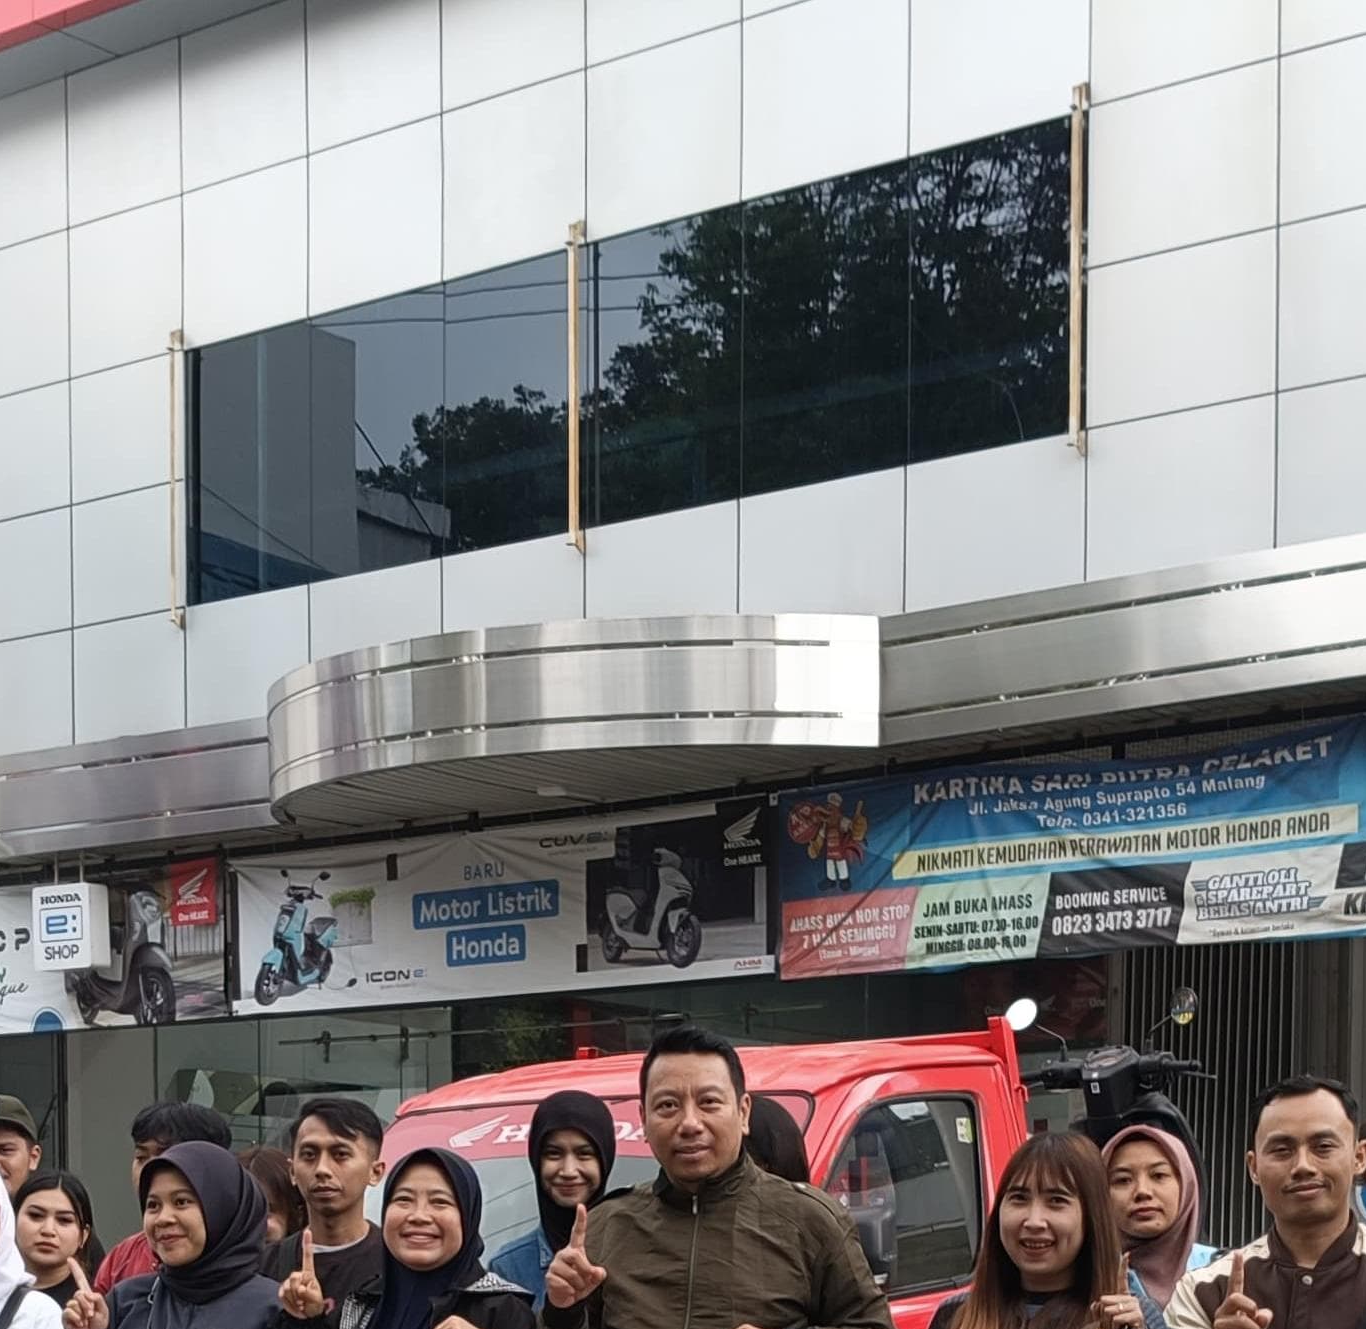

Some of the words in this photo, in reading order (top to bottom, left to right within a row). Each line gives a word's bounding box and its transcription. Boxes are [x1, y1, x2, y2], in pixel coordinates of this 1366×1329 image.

[914, 775, 1024, 804] KARTIKA
[969, 801, 988, 816] Jl.
[1044, 795, 1090, 814] Agung
[1096, 785, 1170, 809] Suprapto
[1176, 782, 1196, 796] 54
[1202, 774, 1265, 793] Malang
[1037, 813, 1077, 829] Telp.
[1082, 802, 1187, 827] 0341-321356
[723, 838, 762, 851] HONDA
[917, 850, 974, 873] NIKMATI
[978, 838, 1067, 867] KEMUDAHAN
[1071, 832, 1162, 858] PERAWATAN
[1167, 826, 1221, 851] MOTOR
[1226, 818, 1281, 843] HONDA
[1286, 812, 1330, 834] ANDA
[463, 860, 504, 881] BARU
[1208, 871, 1264, 890] GANTI
[1266, 867, 1299, 886] OLI
[40, 892, 81, 905] HONDA
[1055, 890, 1110, 910] BOOKING
[1113, 886, 1167, 906] SERVICE
[1207, 881, 1311, 903] SPAREPART
[420, 894, 482, 924] Motor
[487, 885, 553, 918] Listrik
[923, 900, 951, 917] JAM
[954, 897, 987, 915] BUKA
[991, 893, 1032, 911] AHASS
[1197, 900, 1250, 921] BEBAS
[1253, 895, 1309, 915] ANTRI
[45, 914, 77, 935] e:
[790, 916, 823, 933] AHASS
[856, 907, 881, 924] NON
[882, 904, 910, 922] STOP
[1052, 910, 1092, 936] 0823
[1095, 908, 1133, 933] 3473
[1136, 906, 1172, 929] 3717
[451, 931, 520, 961] Honda
[803, 935, 810, 949] 7
[840, 924, 896, 944] SEMINGGU
[44, 944, 80, 961] SHOP
[365, 968, 411, 984] ICON
